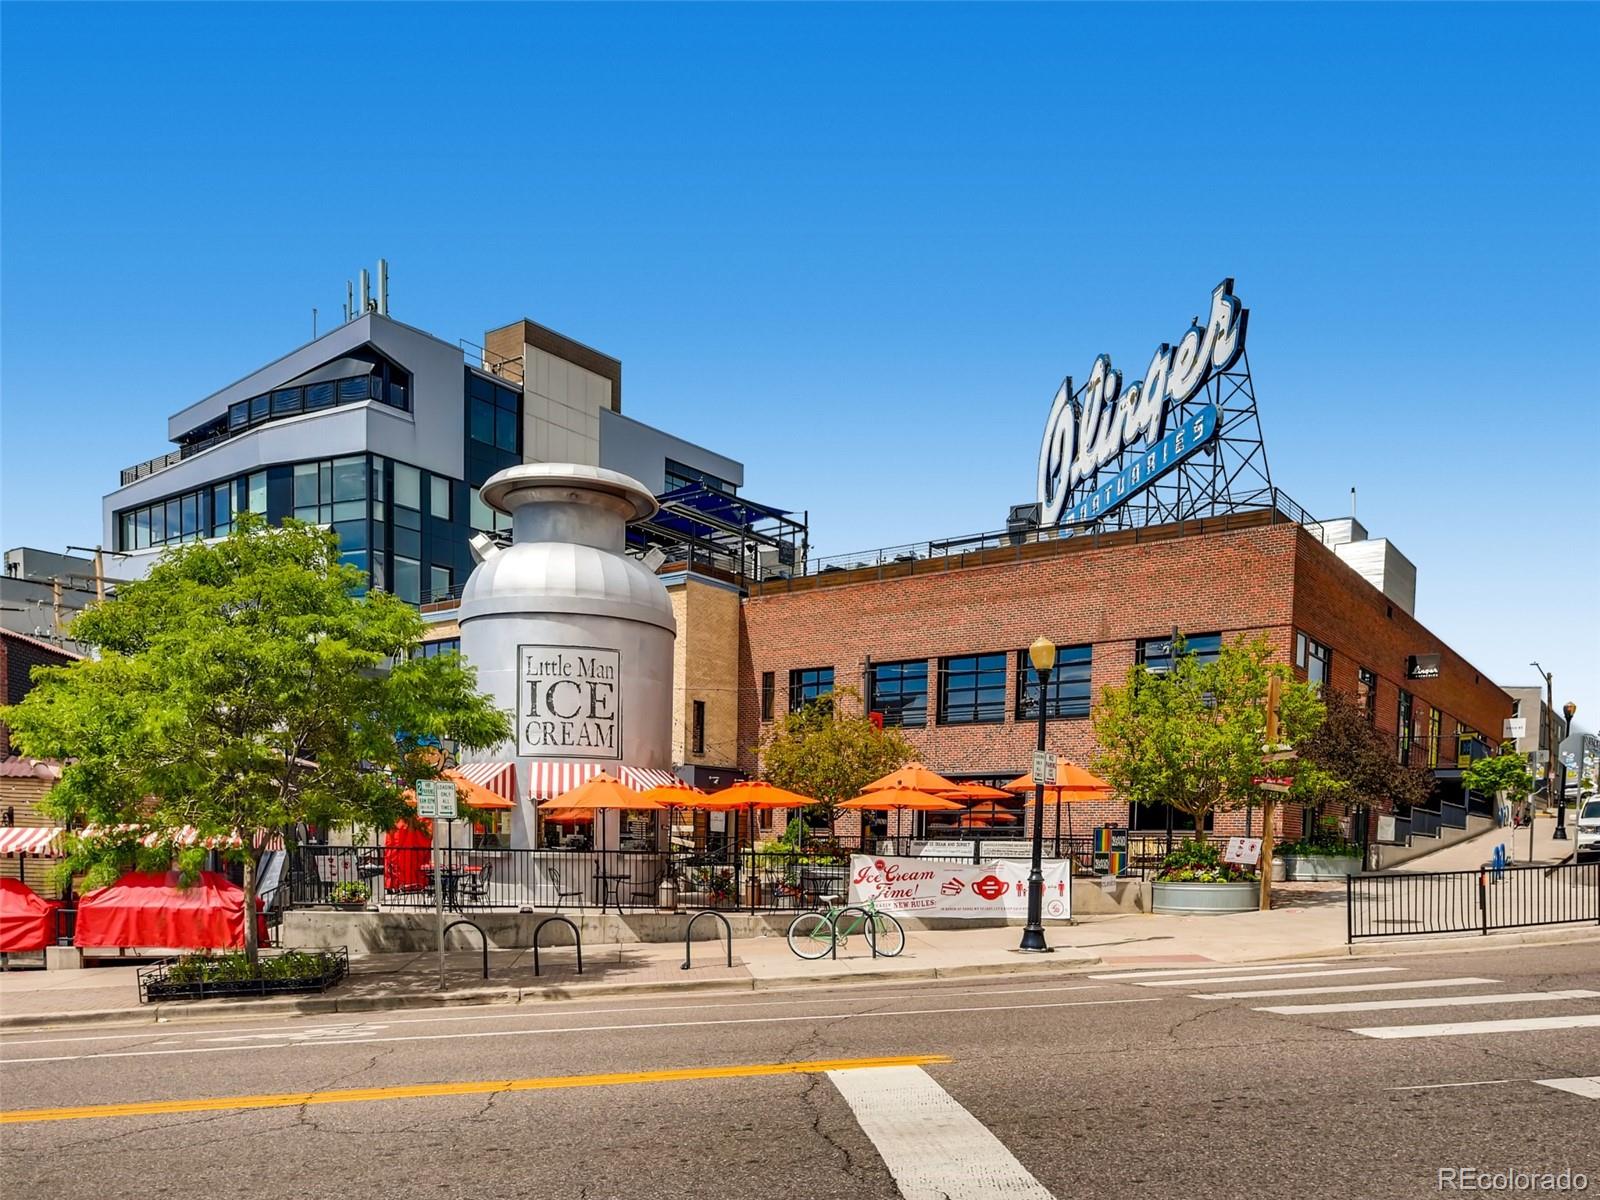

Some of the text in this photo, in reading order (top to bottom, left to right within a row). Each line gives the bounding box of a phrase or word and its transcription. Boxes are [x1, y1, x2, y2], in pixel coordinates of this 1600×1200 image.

[1038, 279, 1246, 522] Olinger
[526, 654, 614, 680] Little Man
[526, 680, 615, 721] ICE
[525, 721, 615, 748] CREAM
[853, 864, 935, 884] Ice Cream
[874, 882, 919, 901] Time!
